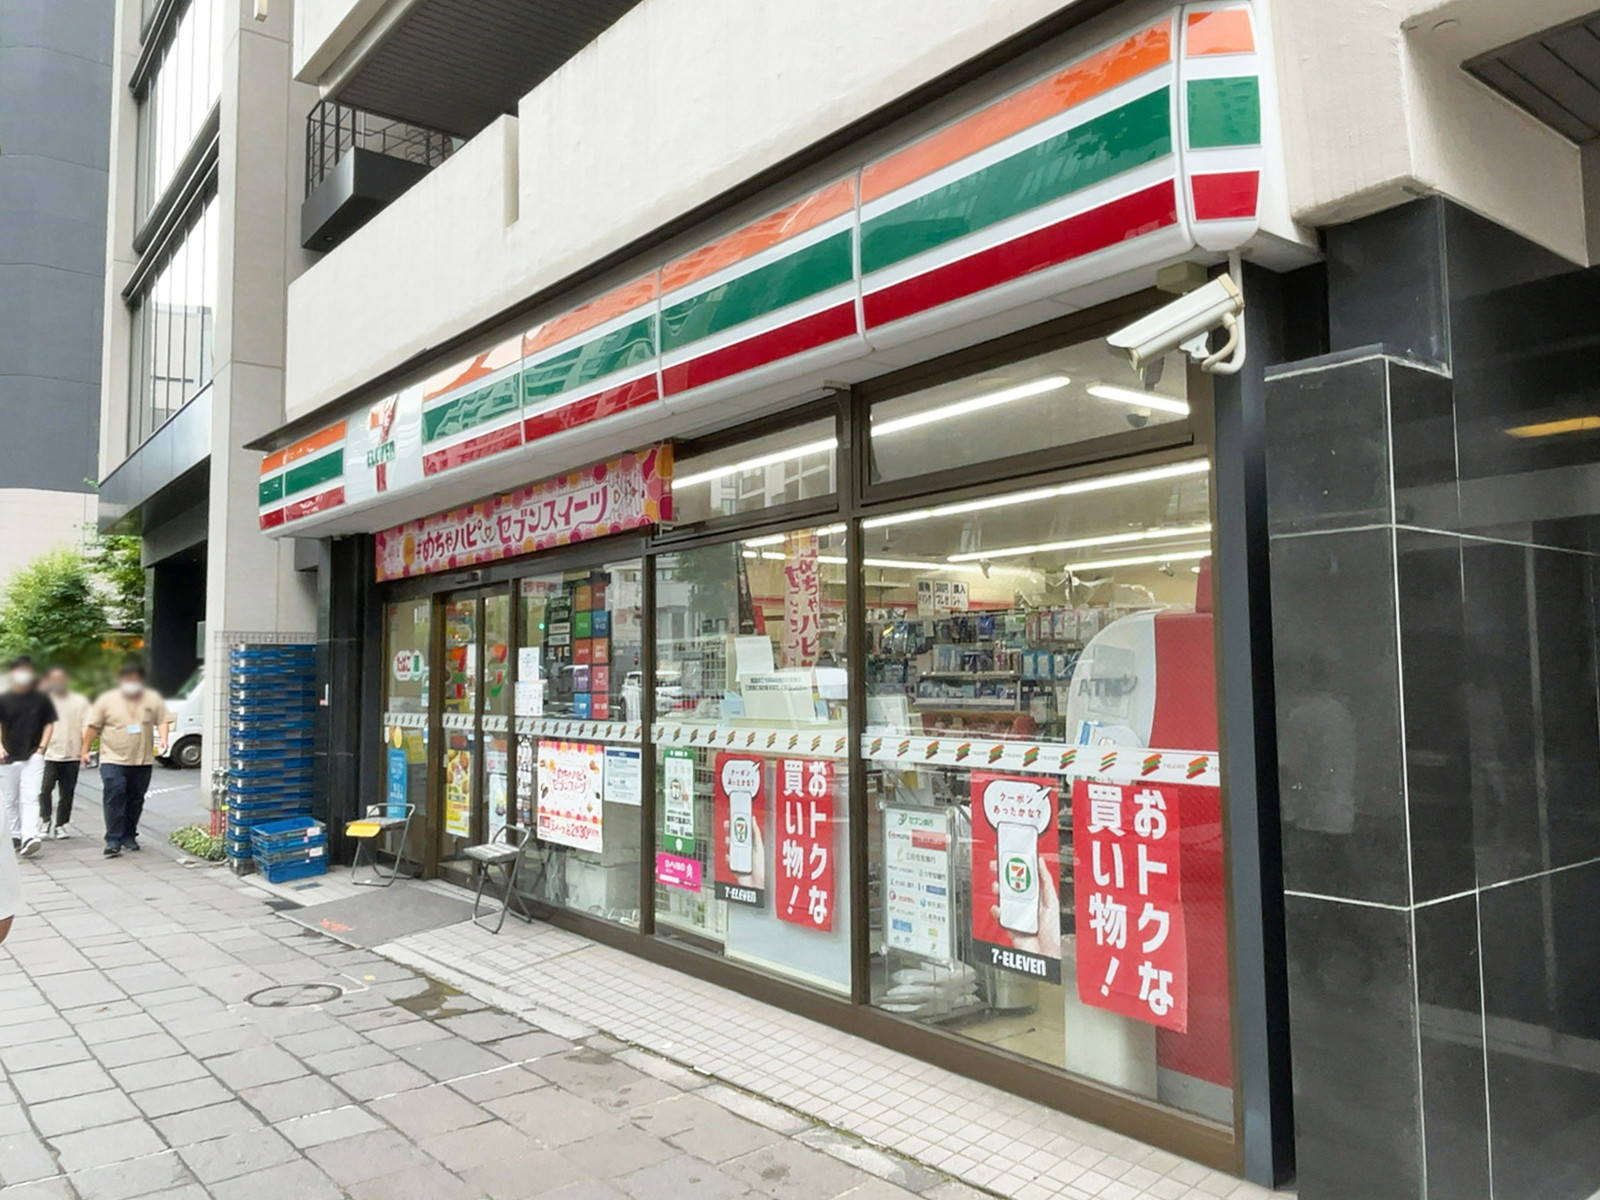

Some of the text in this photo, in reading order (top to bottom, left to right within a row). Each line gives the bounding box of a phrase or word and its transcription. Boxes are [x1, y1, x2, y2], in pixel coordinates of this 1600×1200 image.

[496, 485, 608, 544] セブンスイーツ
[1078, 679, 1122, 697] ATM
[993, 807, 1042, 819] あったかな?
[999, 792, 1034, 805] クーポン
[808, 760, 828, 924] おトクな
[1087, 784, 1127, 997] 買い物!
[1132, 788, 1174, 1016] おトクな
